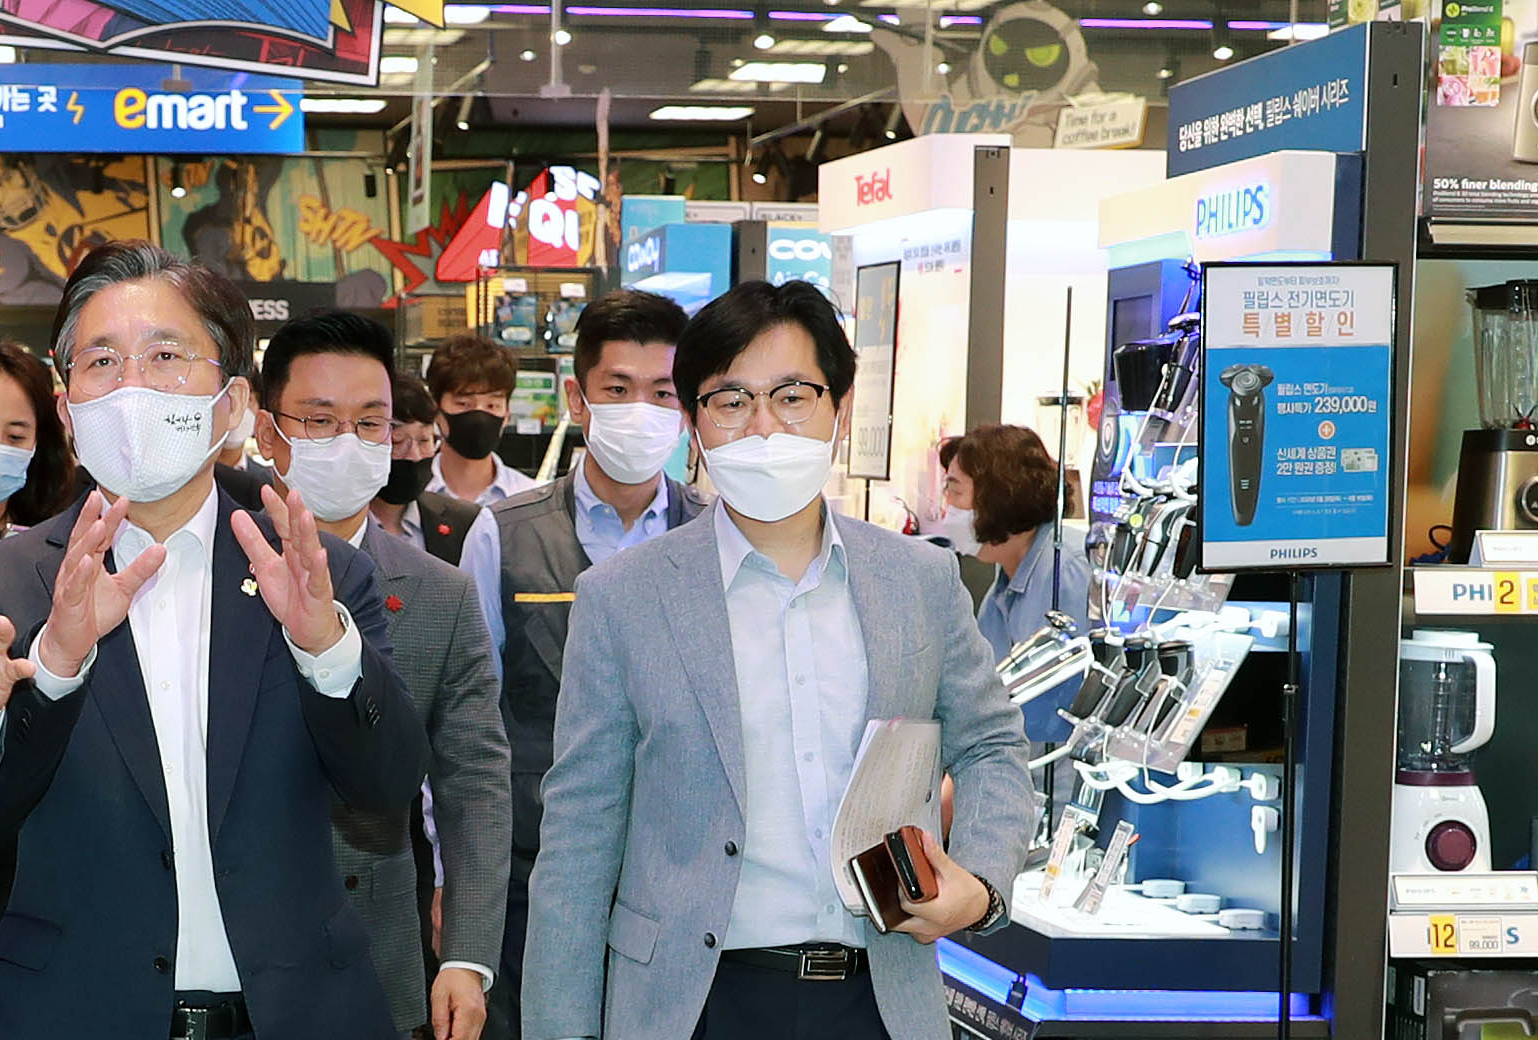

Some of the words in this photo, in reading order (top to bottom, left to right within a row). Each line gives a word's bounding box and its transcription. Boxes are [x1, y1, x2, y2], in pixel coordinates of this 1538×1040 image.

[37, 86, 57, 113] 곳
[113, 86, 249, 130] emart
[1178, 122, 1202, 152] 당신을
[1203, 114, 1219, 145] 위한
[1219, 108, 1245, 141] 완벽한
[1265, 95, 1293, 128] 필립스
[1292, 84, 1320, 119] 쉐이버
[1320, 78, 1350, 109] 시리즈
[854, 167, 893, 207] Tefal
[1433, 178, 1459, 190] 50%
[1460, 178, 1488, 190] finer
[1489, 178, 1538, 193] blending
[1196, 184, 1266, 236] PHILIPS
[1242, 290, 1283, 310] 필립스
[1287, 290, 1355, 309] 전기면도기
[1270, 546, 1318, 560] PHILIPS
[1499, 579, 1515, 605] 2
[1432, 923, 1455, 948] 12
